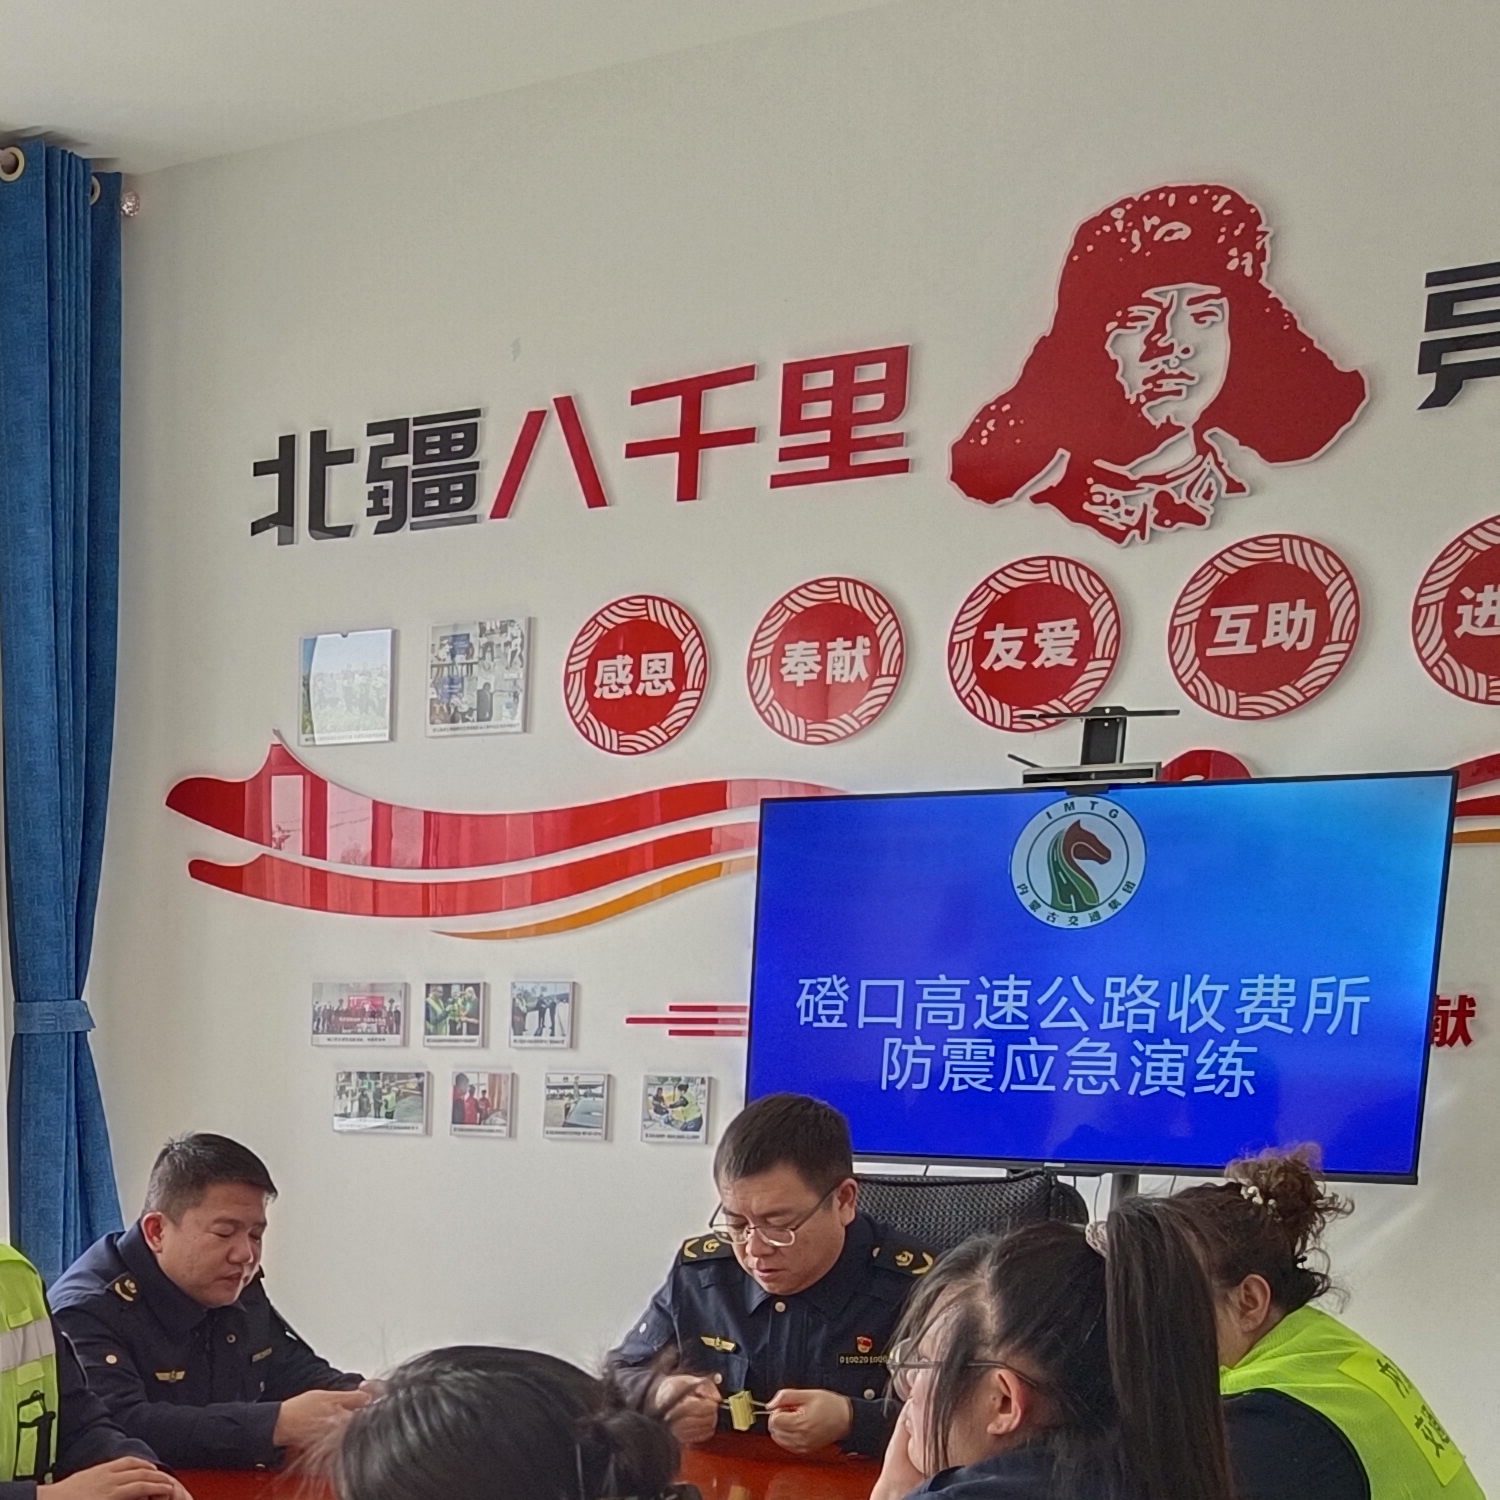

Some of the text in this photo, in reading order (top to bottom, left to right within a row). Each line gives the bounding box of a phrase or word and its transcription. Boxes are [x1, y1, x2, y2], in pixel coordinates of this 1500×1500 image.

[250, 344, 911, 546] 北疆八千里
[981, 618, 1081, 671] 友爱
[1206, 599, 1317, 657] 互助
[593, 652, 677, 700] 感恩
[780, 636, 872, 687] 奉献
[1045, 800, 1119, 820] IMTG
[795, 974, 1371, 1037] 磴口高速公路收费所
[880, 1036, 1259, 1099] 防震应急演练
